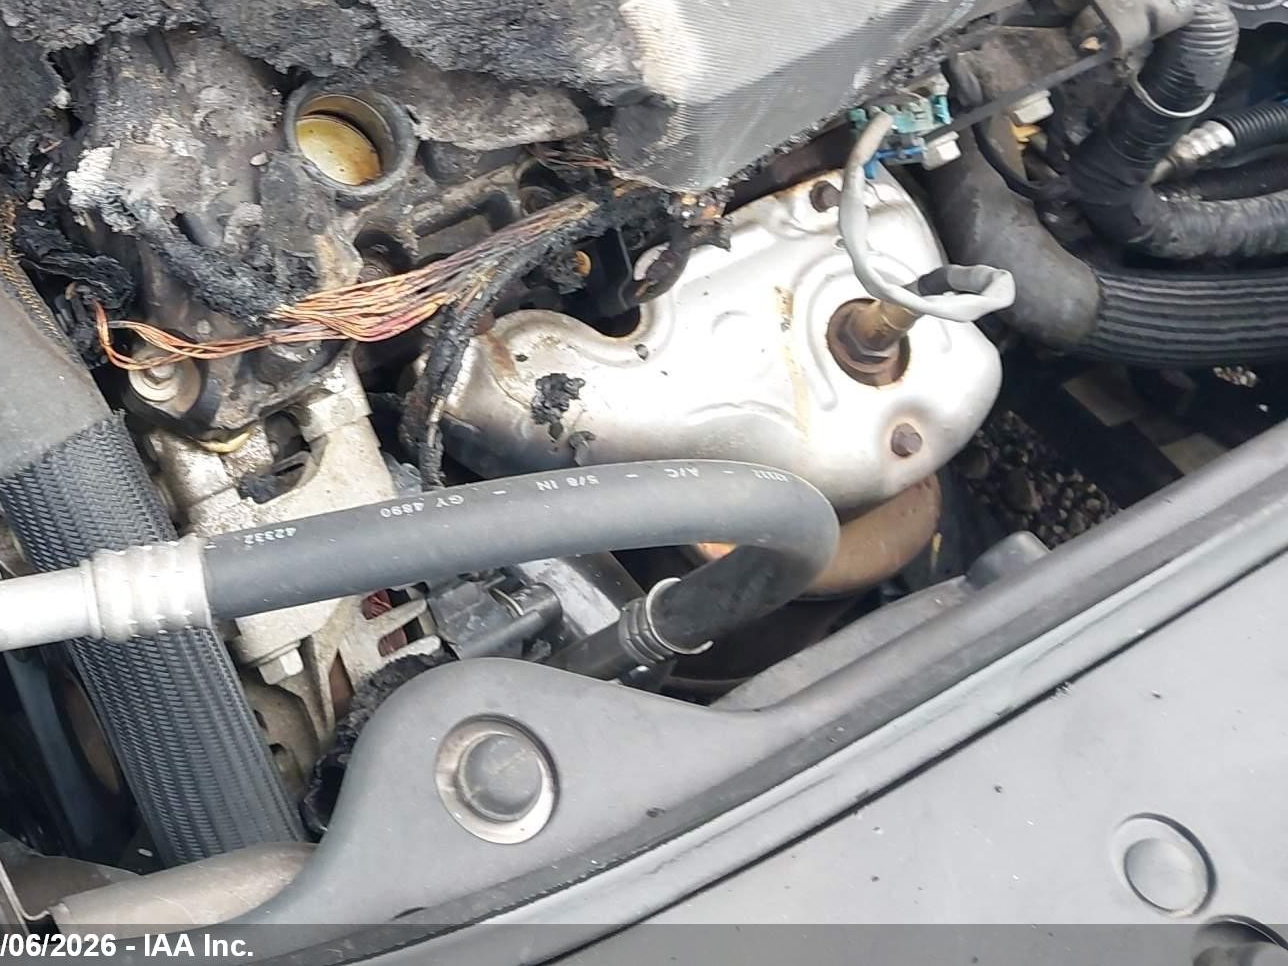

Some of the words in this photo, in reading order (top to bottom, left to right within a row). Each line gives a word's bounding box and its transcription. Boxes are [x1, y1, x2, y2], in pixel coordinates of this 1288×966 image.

[664, 467, 699, 478] A/C
[536, 480, 560, 491] IN
[566, 475, 600, 487] 5/8
[435, 494, 464, 507] GY
[380, 502, 424, 517] 4890
[244, 527, 297, 545] 42332
